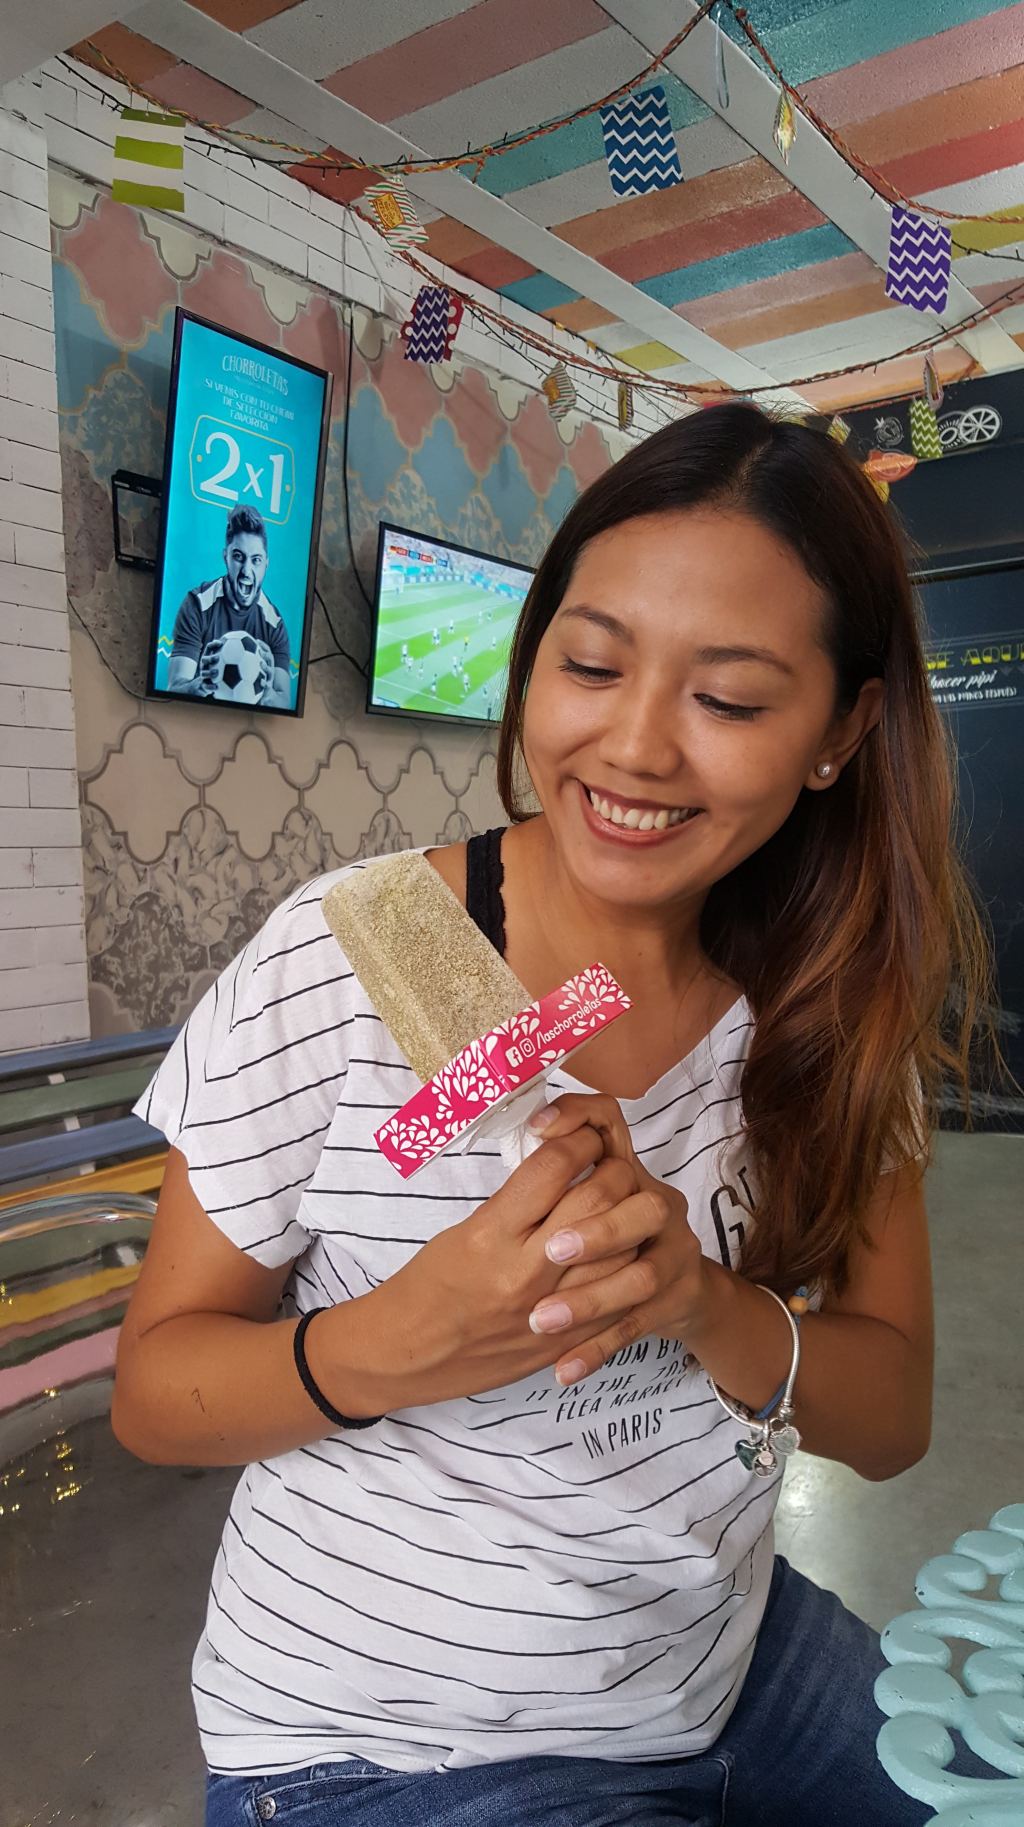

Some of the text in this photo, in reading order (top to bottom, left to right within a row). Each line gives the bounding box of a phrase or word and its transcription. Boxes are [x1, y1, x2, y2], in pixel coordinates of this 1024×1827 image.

[222, 355, 289, 396] CHORROLETAS
[230, 409, 269, 431] FAVORITA
[526, 1388, 552, 1401] IT
[558, 1384, 586, 1399] IN
[594, 1373, 637, 1394] THE
[556, 1397, 602, 1423] FLEA
[582, 1408, 663, 1459] IN PARIS
